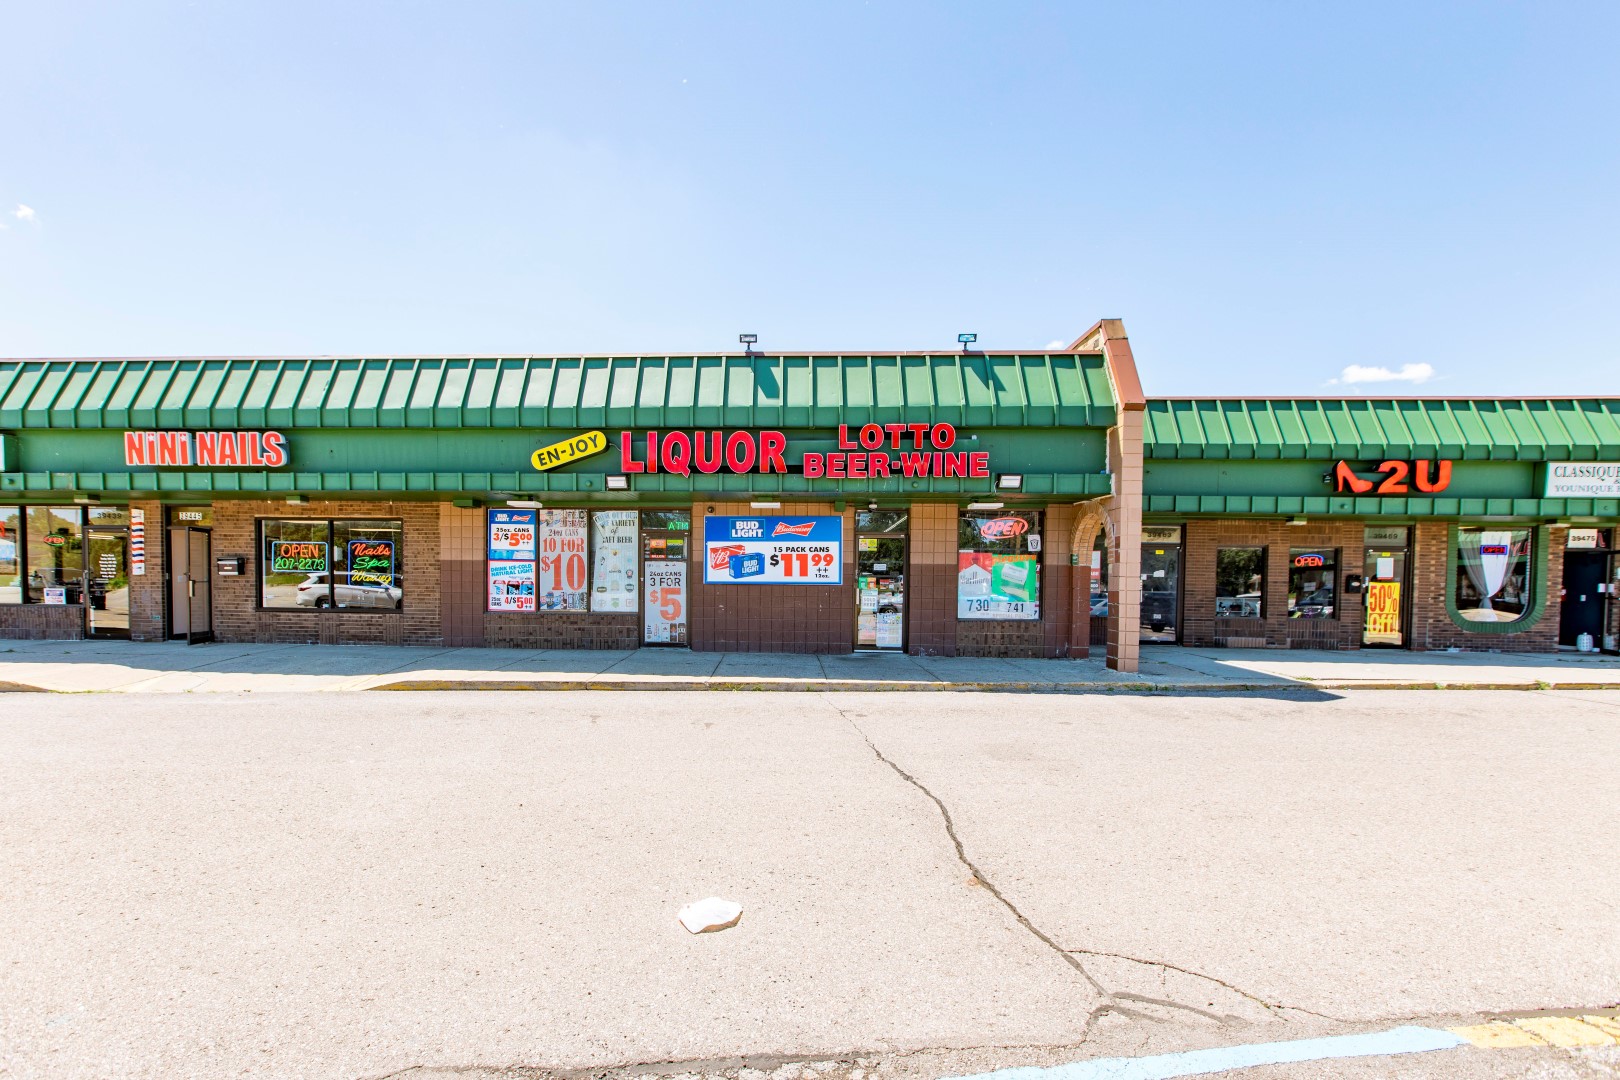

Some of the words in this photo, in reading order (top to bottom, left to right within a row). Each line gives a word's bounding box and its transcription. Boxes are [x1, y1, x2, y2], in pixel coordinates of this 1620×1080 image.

[838, 423, 956, 450] LOTTO
[196, 431, 286, 467] NAILS
[537, 433, 599, 467] EN-JOY
[620, 431, 788, 478] LIQUOR
[1554, 485, 1613, 494] YOUNIQUE
[668, 521, 689, 530] ATM
[736, 521, 759, 529] BUD
[777, 524, 811, 534] Budweiser
[983, 521, 1024, 535] OPEN
[731, 529, 763, 538] LIGHT
[281, 544, 320, 558] OPEN
[351, 542, 391, 556] Nails
[543, 538, 557, 552] 10
[561, 538, 585, 552] FOR
[275, 557, 325, 570] 207-2273
[353, 557, 390, 570] Spa
[744, 560, 758, 568] BUD
[1295, 557, 1323, 567] OPEN
[541, 554, 586, 591] $10
[742, 565, 760, 573] LIGHT
[649, 578, 656, 587] 3
[659, 578, 681, 587] FOR
[649, 587, 682, 621] $5
[1369, 585, 1398, 613] 50%
